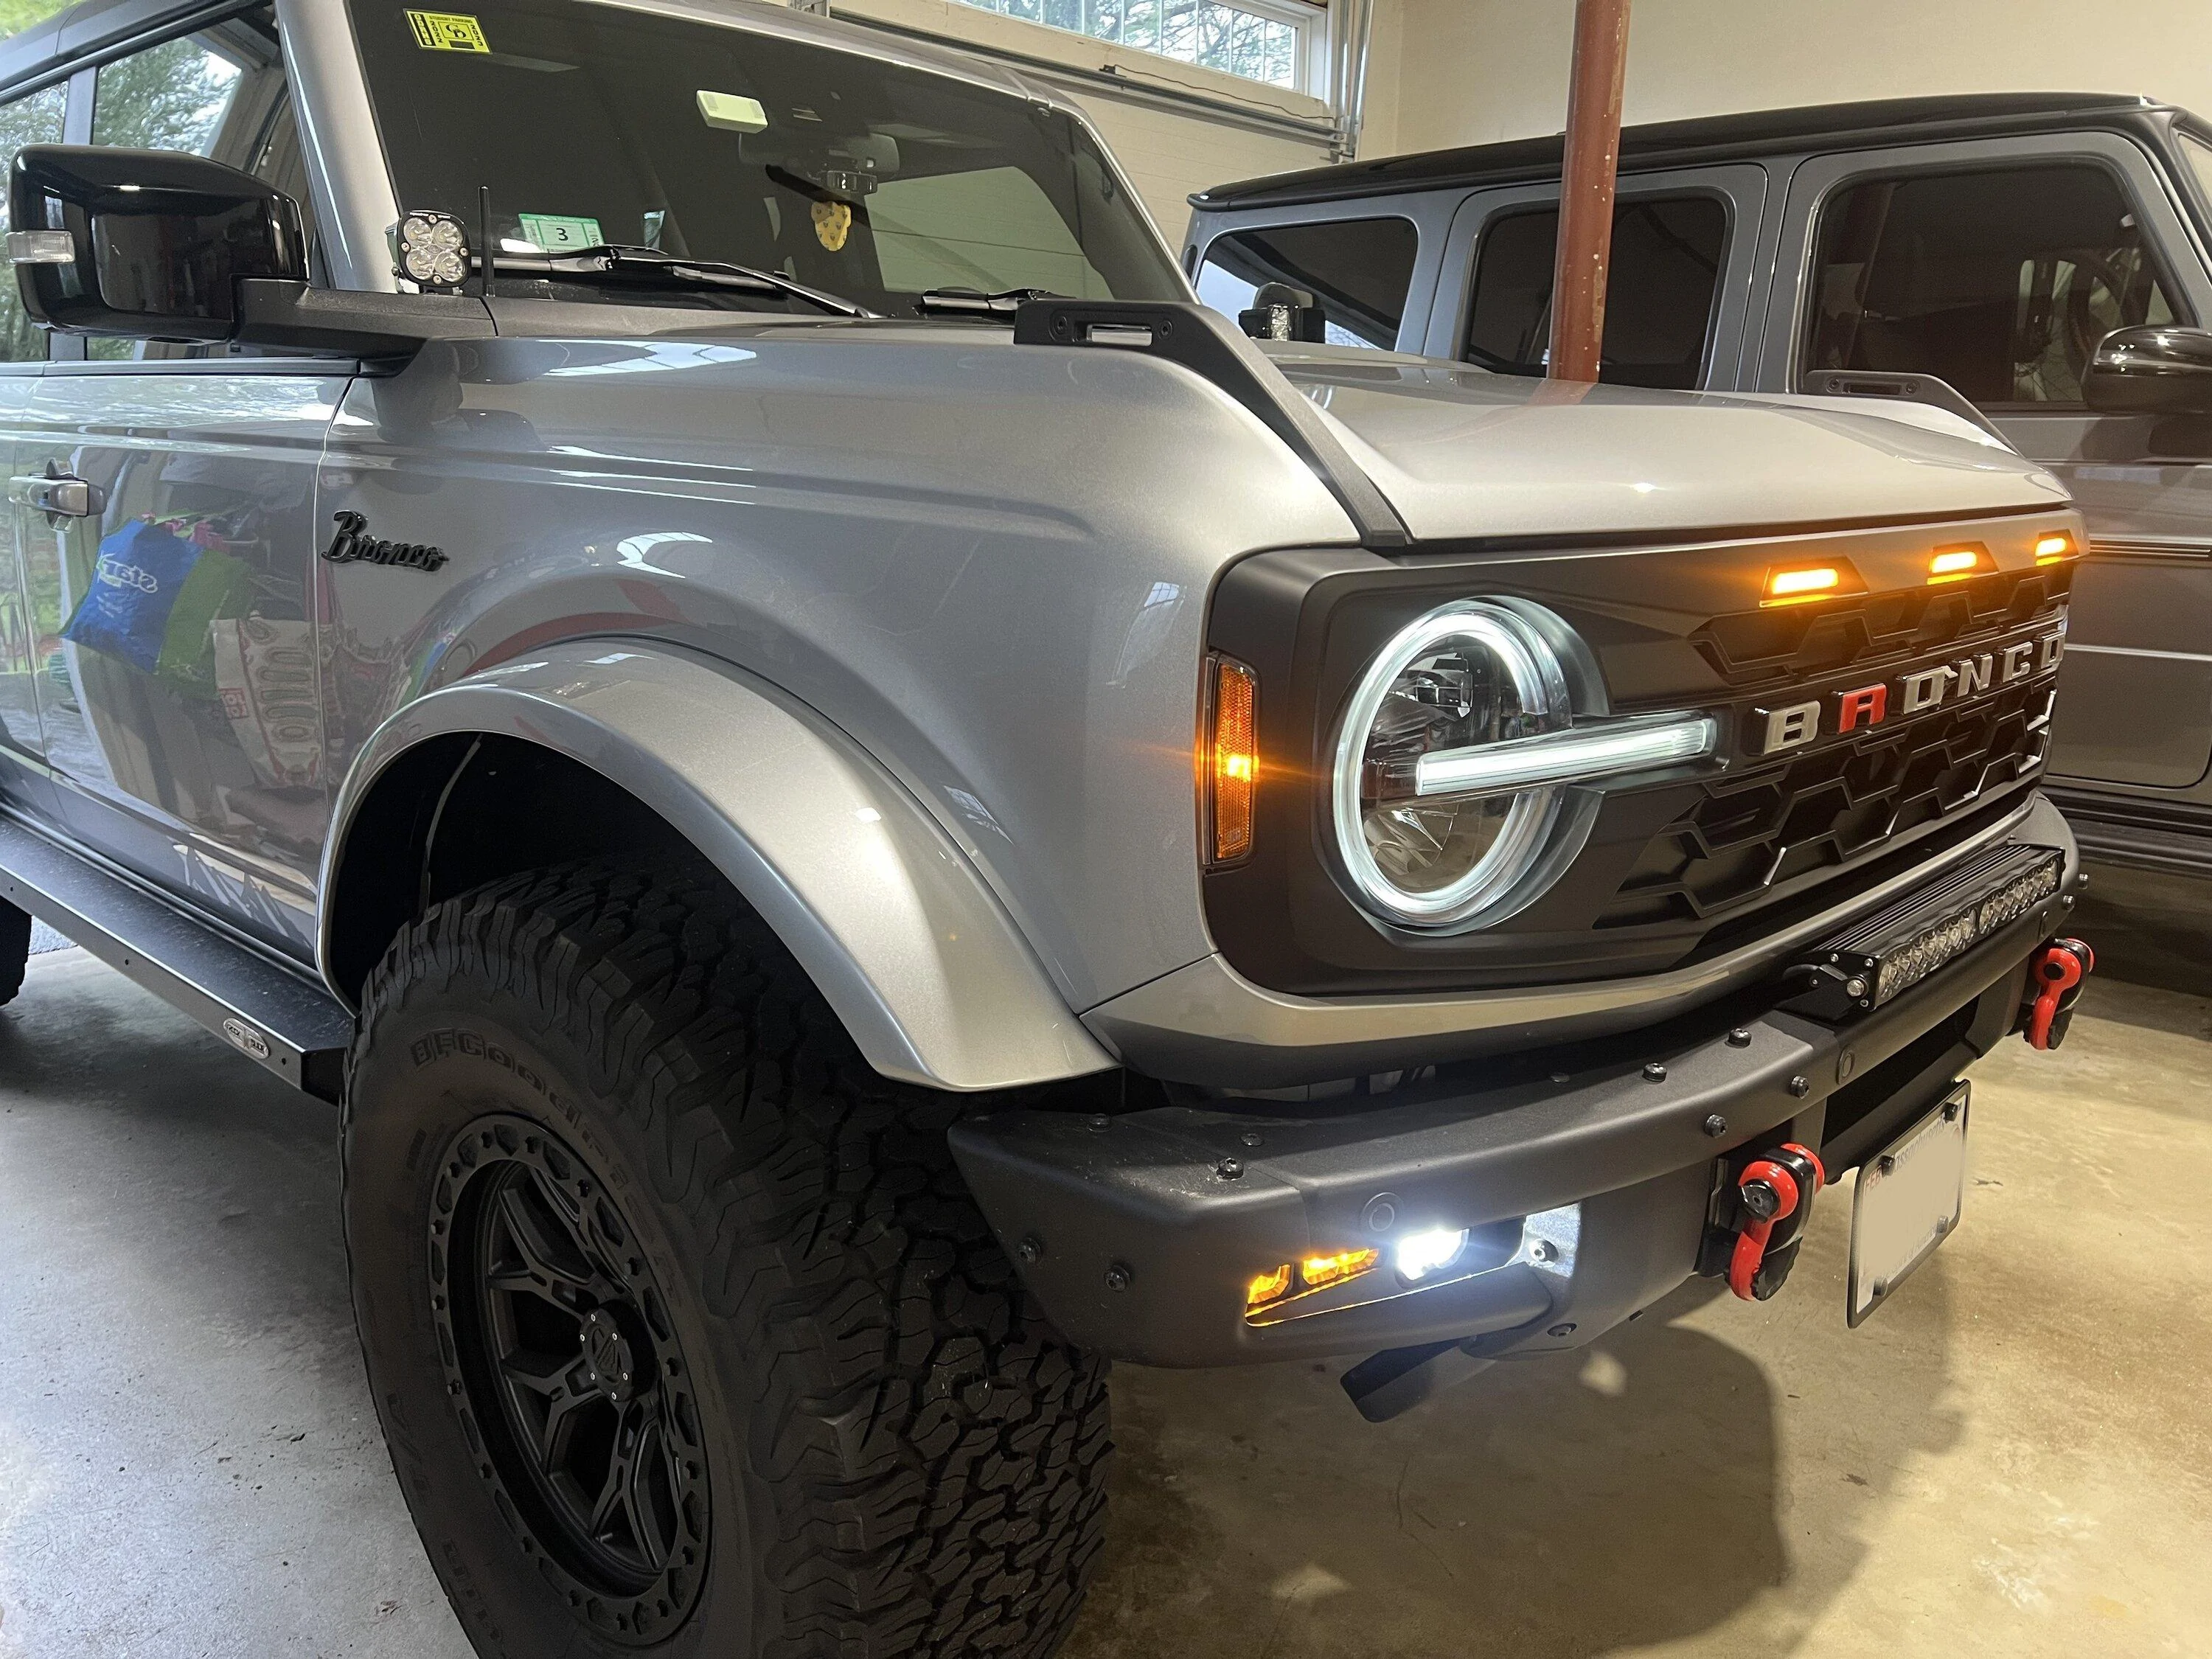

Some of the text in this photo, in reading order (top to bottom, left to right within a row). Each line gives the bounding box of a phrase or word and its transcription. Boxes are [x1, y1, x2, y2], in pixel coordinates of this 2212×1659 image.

[430, 21, 443, 44] 2022
[556, 227, 568, 241] 3
[321, 509, 450, 571] Bronco
[1756, 630, 2065, 756] BRONCO
